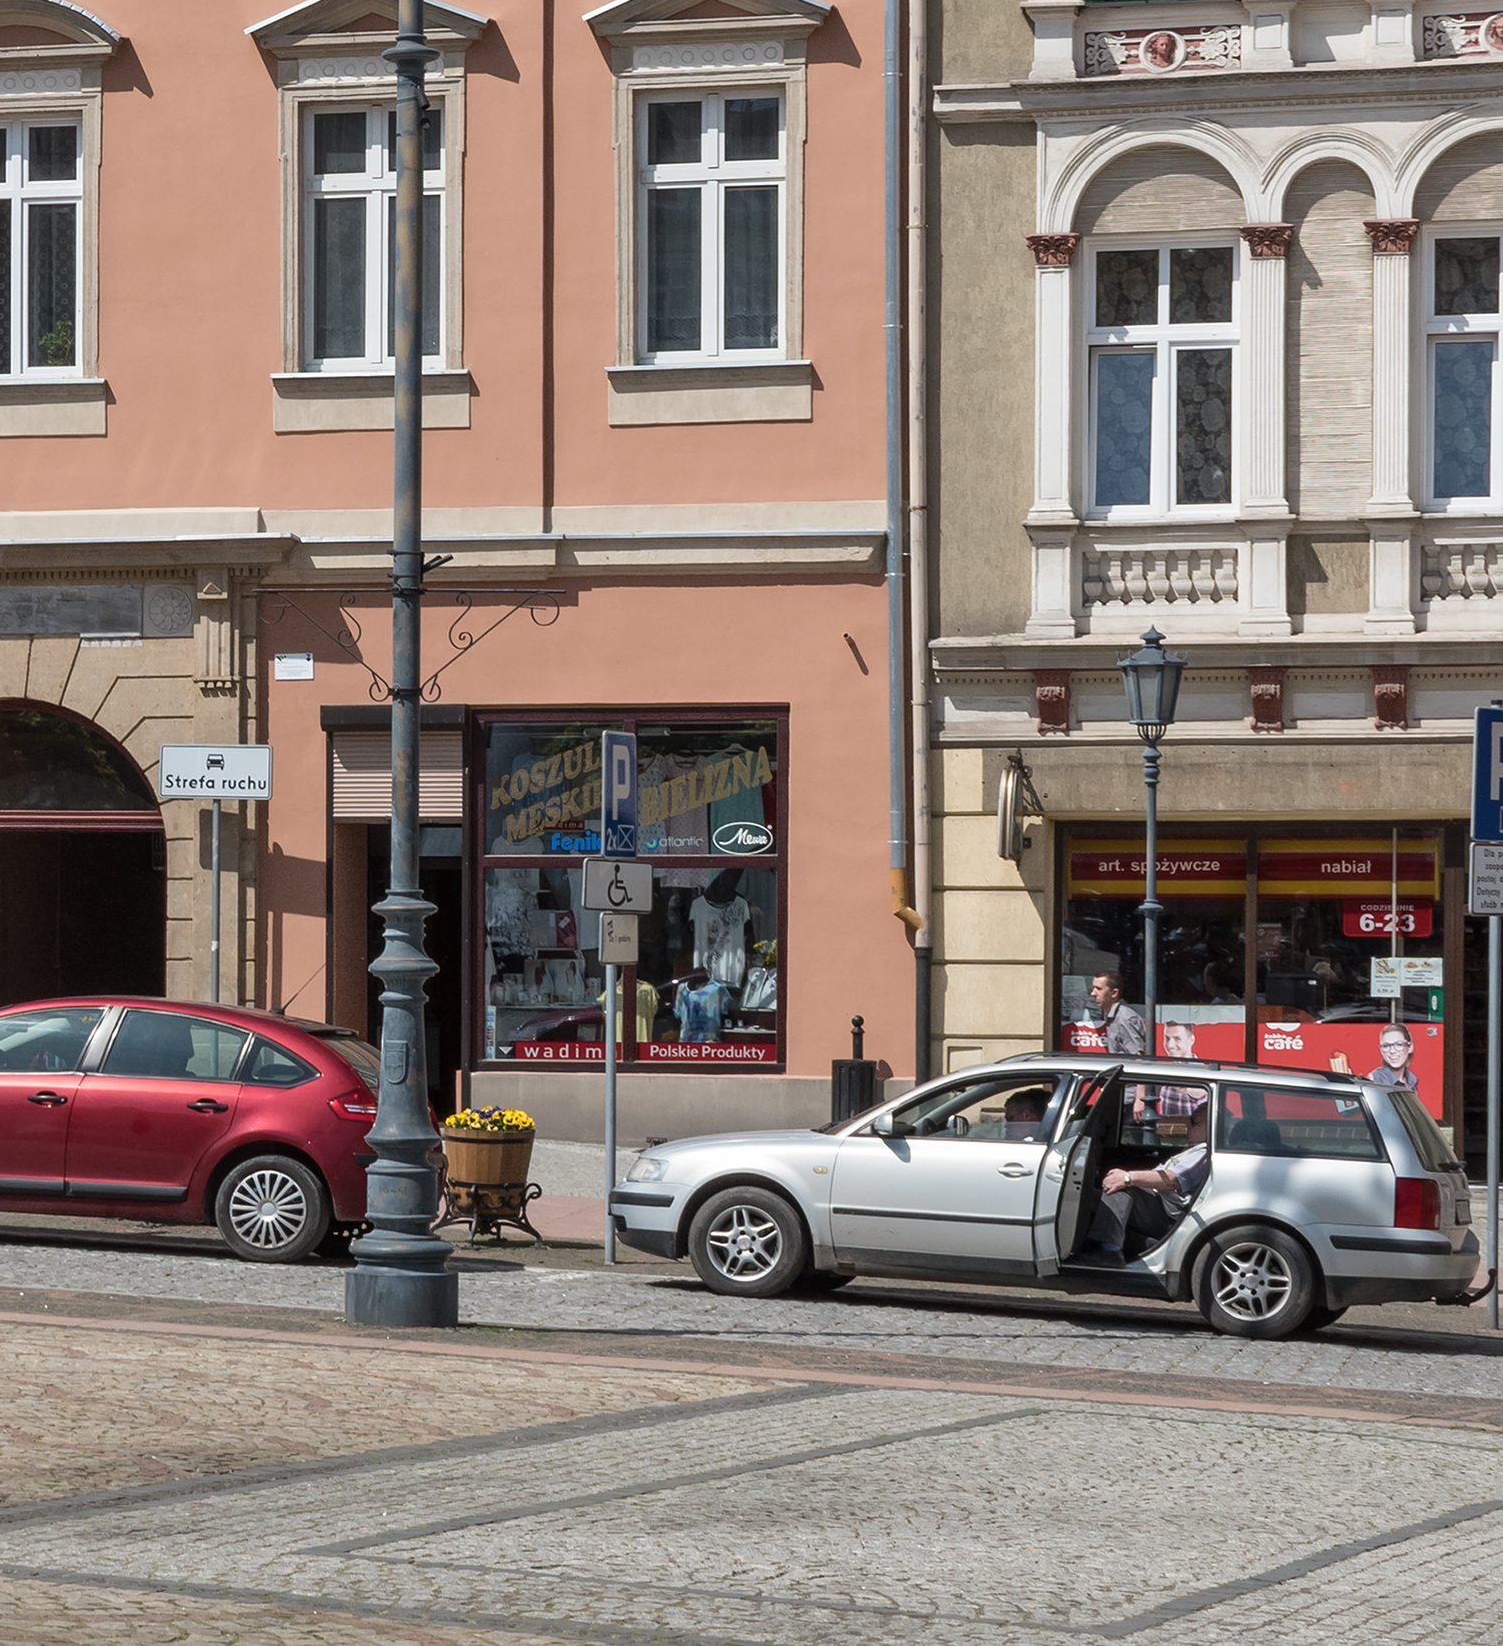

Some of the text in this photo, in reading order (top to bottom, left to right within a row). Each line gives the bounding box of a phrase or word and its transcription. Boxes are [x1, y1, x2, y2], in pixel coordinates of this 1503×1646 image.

[165, 774, 267, 790] Strefa ruchu
[490, 738, 602, 810] KOSZUL
[612, 744, 630, 821] P
[640, 745, 773, 827] BIELIZNA
[1098, 859, 1125, 872] art.
[1321, 860, 1372, 874] nabiał
[1359, 913, 1416, 933] 6-23
[1070, 1032, 1108, 1047] café
[1263, 1035, 1304, 1050] café
[524, 1043, 617, 1059] wadim
[650, 1044, 766, 1061] Polskie Produkty
